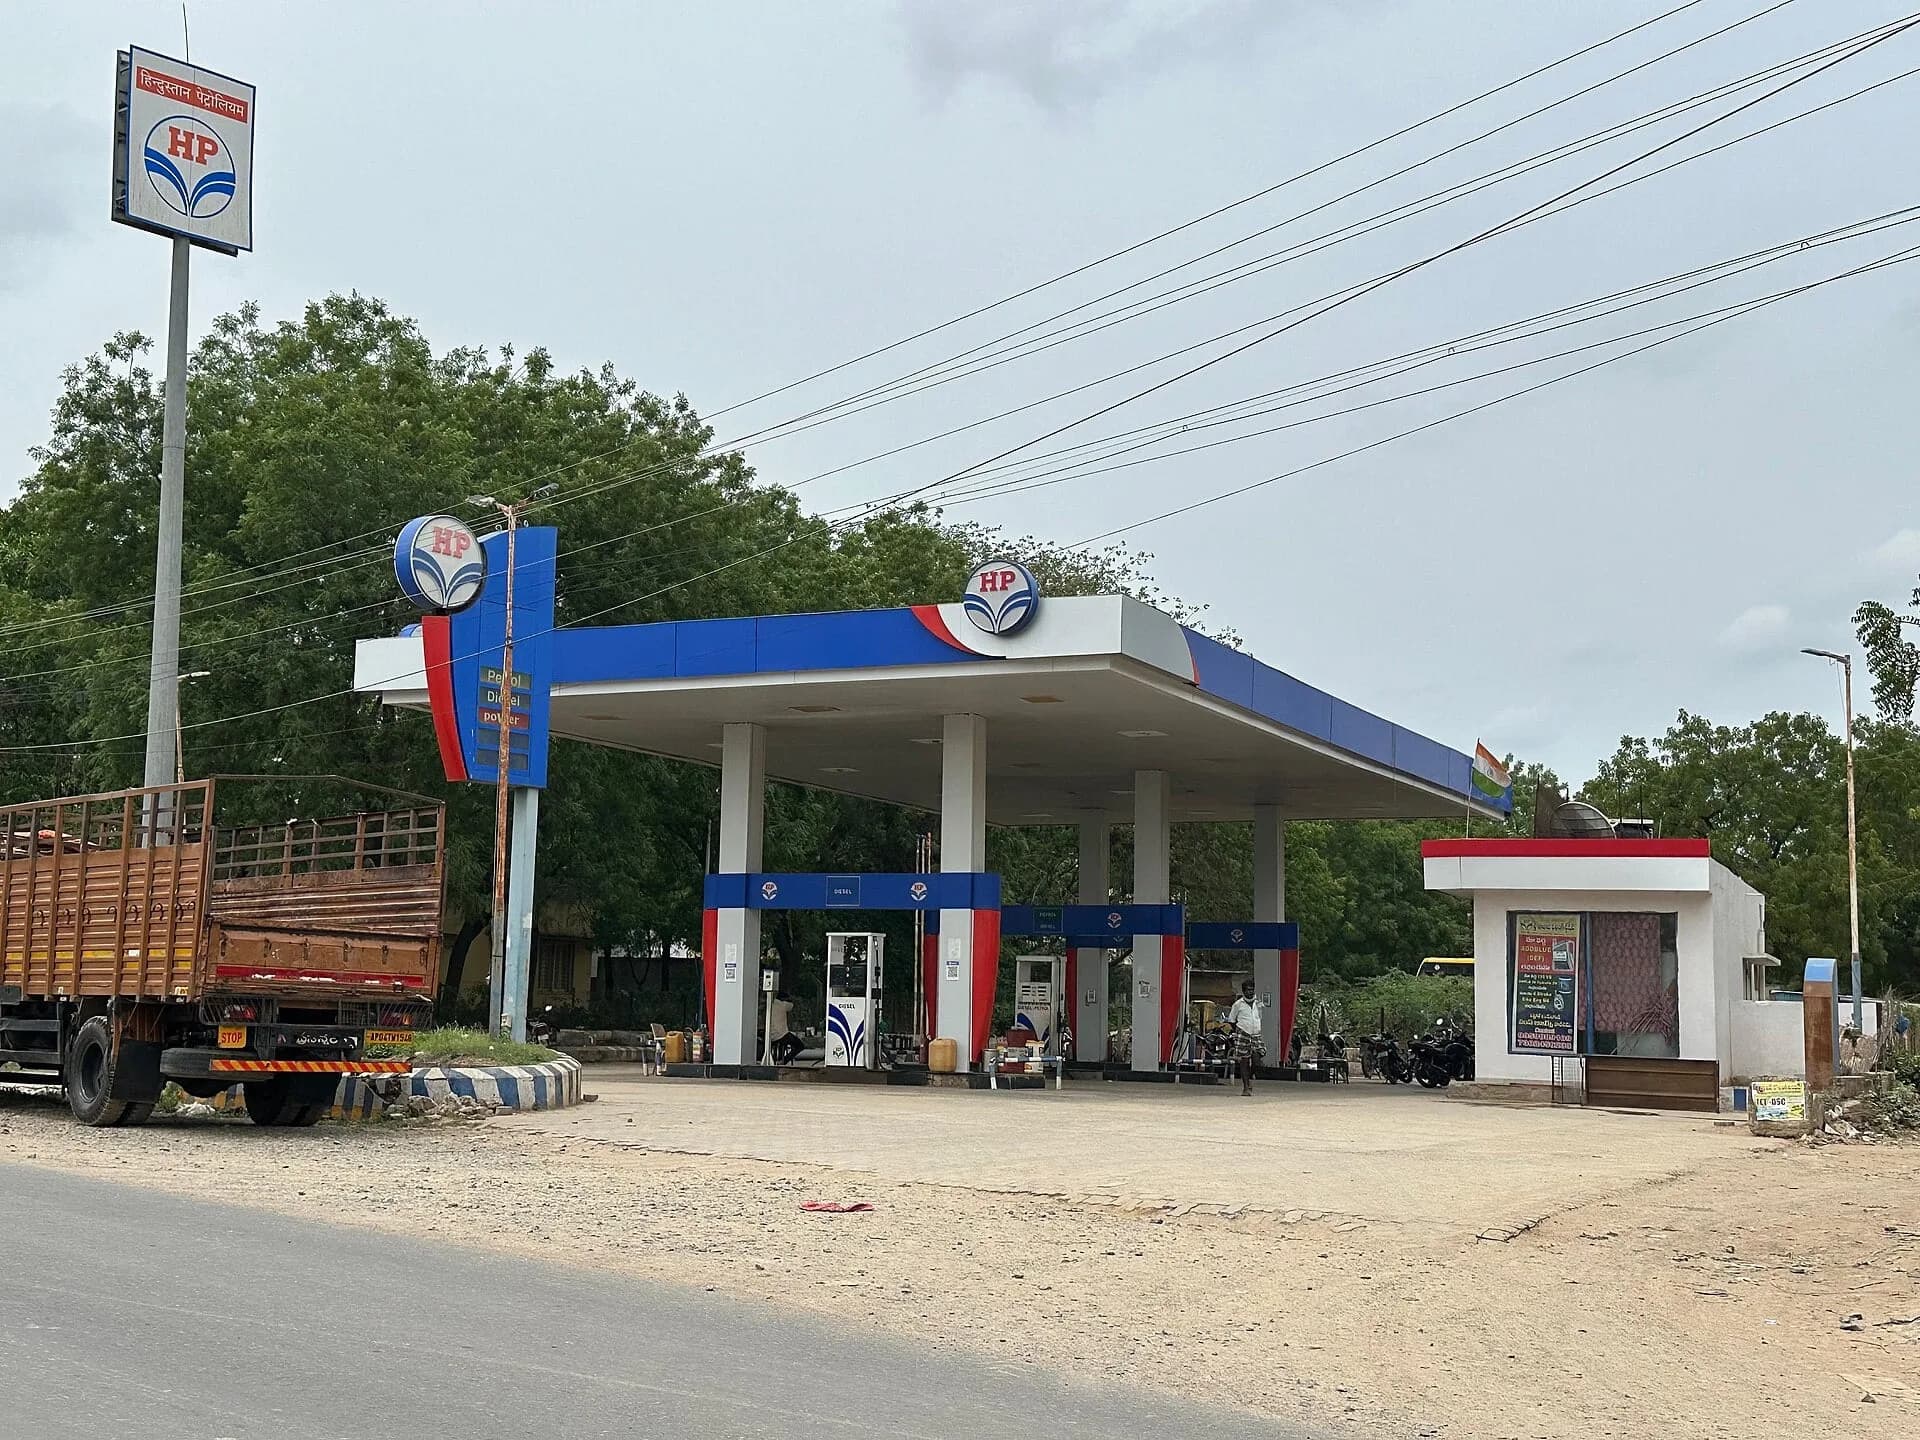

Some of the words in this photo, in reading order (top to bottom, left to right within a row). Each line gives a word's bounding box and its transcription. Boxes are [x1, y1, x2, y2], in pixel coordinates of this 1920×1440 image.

[140, 69, 191, 100] हिन्दुस्तान
[196, 86, 245, 117] पेट्रोलियम
[168, 126, 219, 165] HP
[432, 526, 471, 559] HP
[979, 570, 1016, 592] HP
[488, 670, 521, 688] Peol
[221, 1032, 243, 1044] STOP
